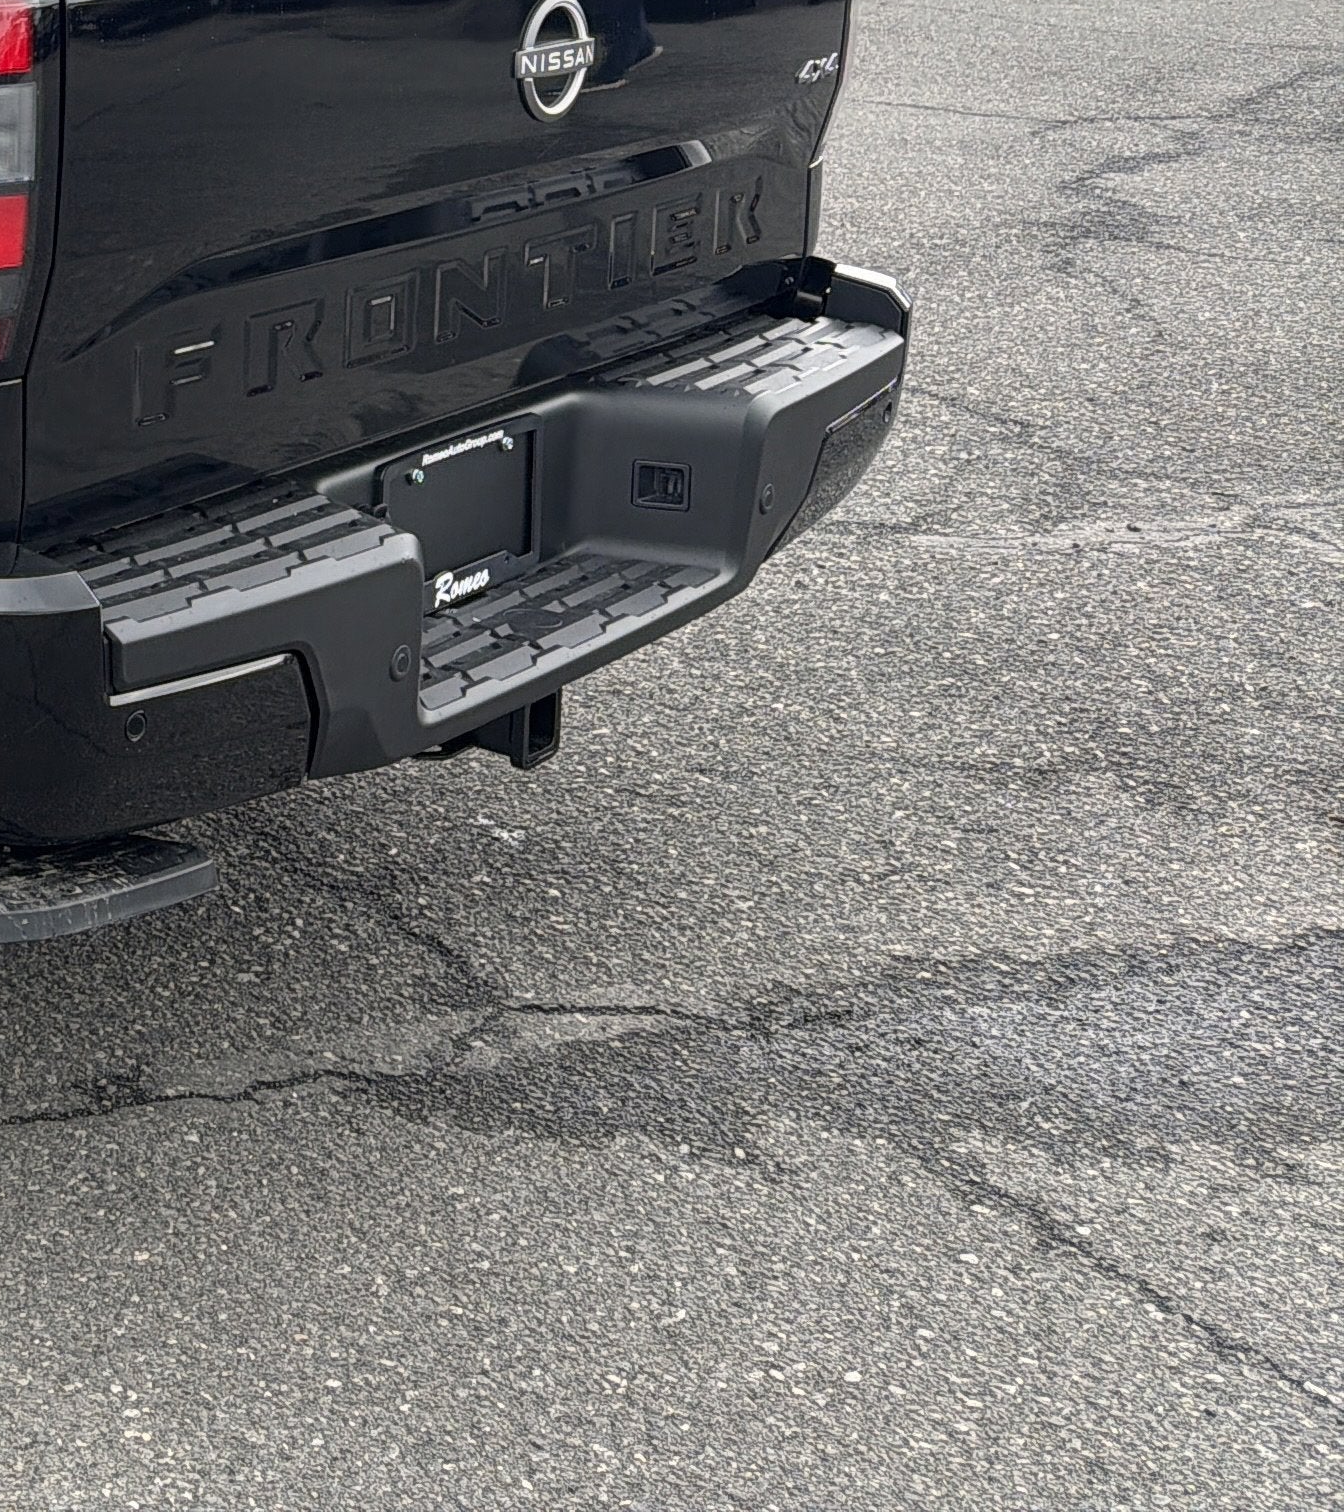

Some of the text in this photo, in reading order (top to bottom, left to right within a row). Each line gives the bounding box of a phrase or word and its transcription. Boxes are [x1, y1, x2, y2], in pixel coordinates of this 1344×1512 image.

[520, 44, 593, 75] NISSAN
[132, 175, 764, 427] FRONTIER
[421, 429, 505, 468] RomeoAutoGroup.com
[434, 568, 490, 609] Romeo
